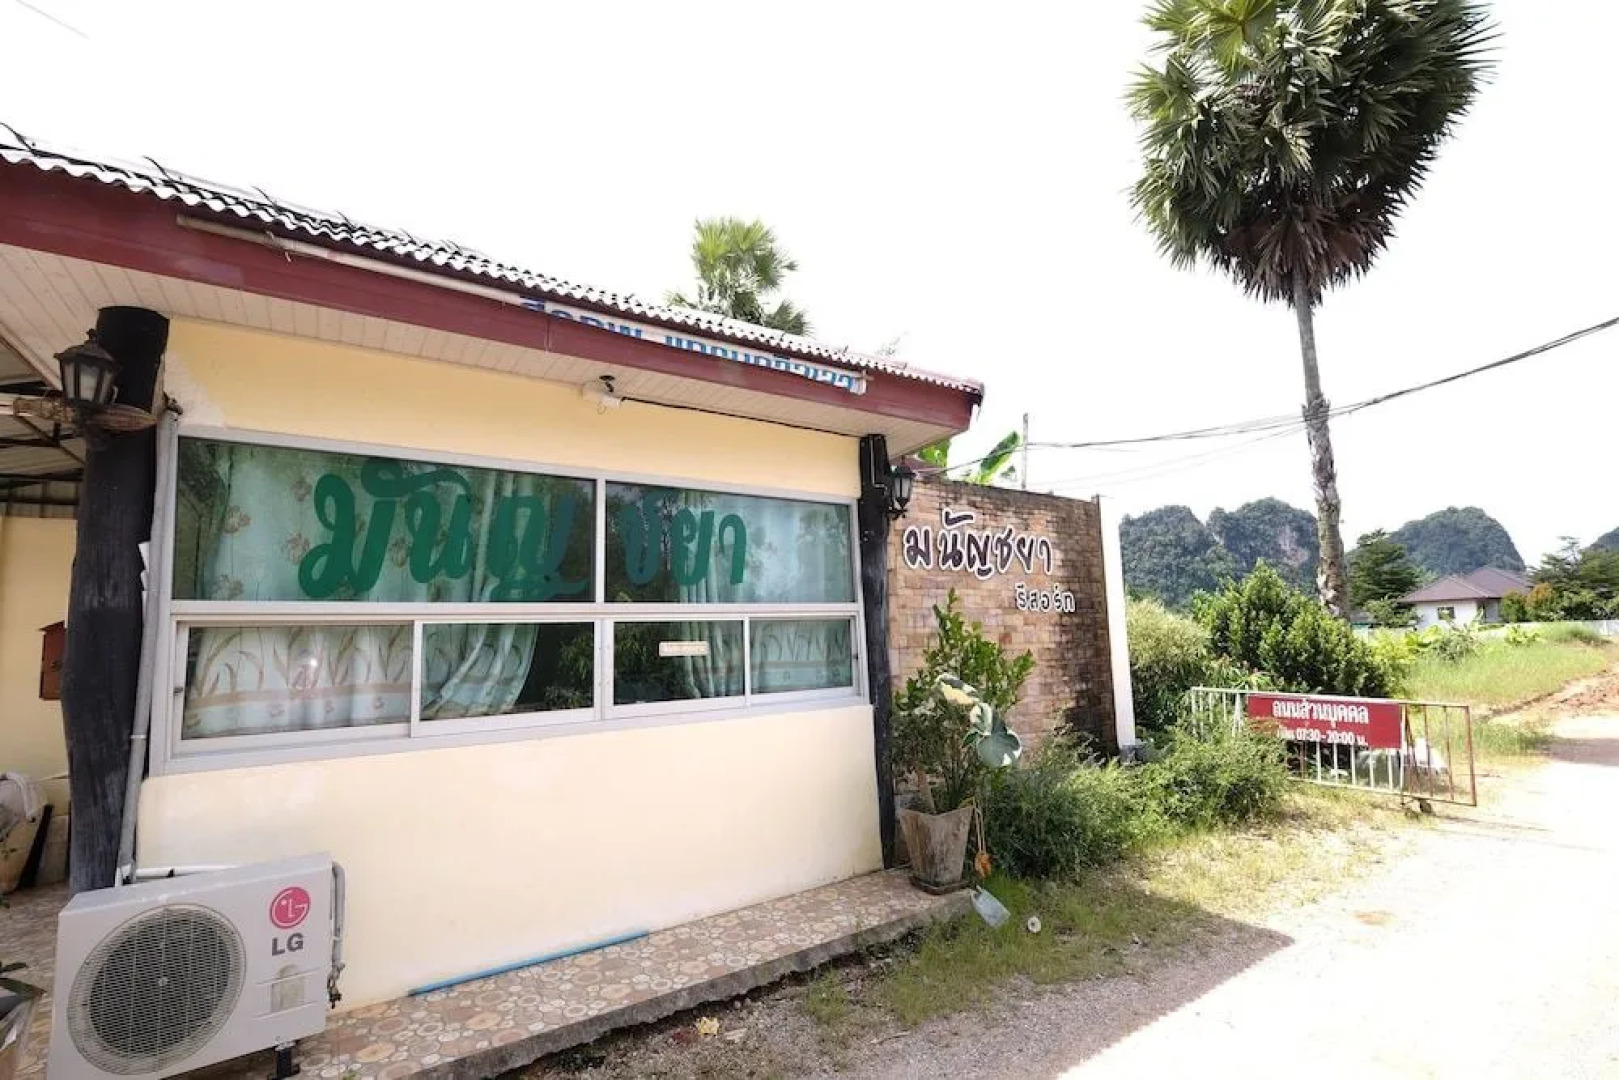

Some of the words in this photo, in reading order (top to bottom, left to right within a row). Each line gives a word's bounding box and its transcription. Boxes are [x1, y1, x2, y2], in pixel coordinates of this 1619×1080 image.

[1272, 698, 1369, 728] ถนนส่วนบุคคล
[271, 932, 304, 956] LG
